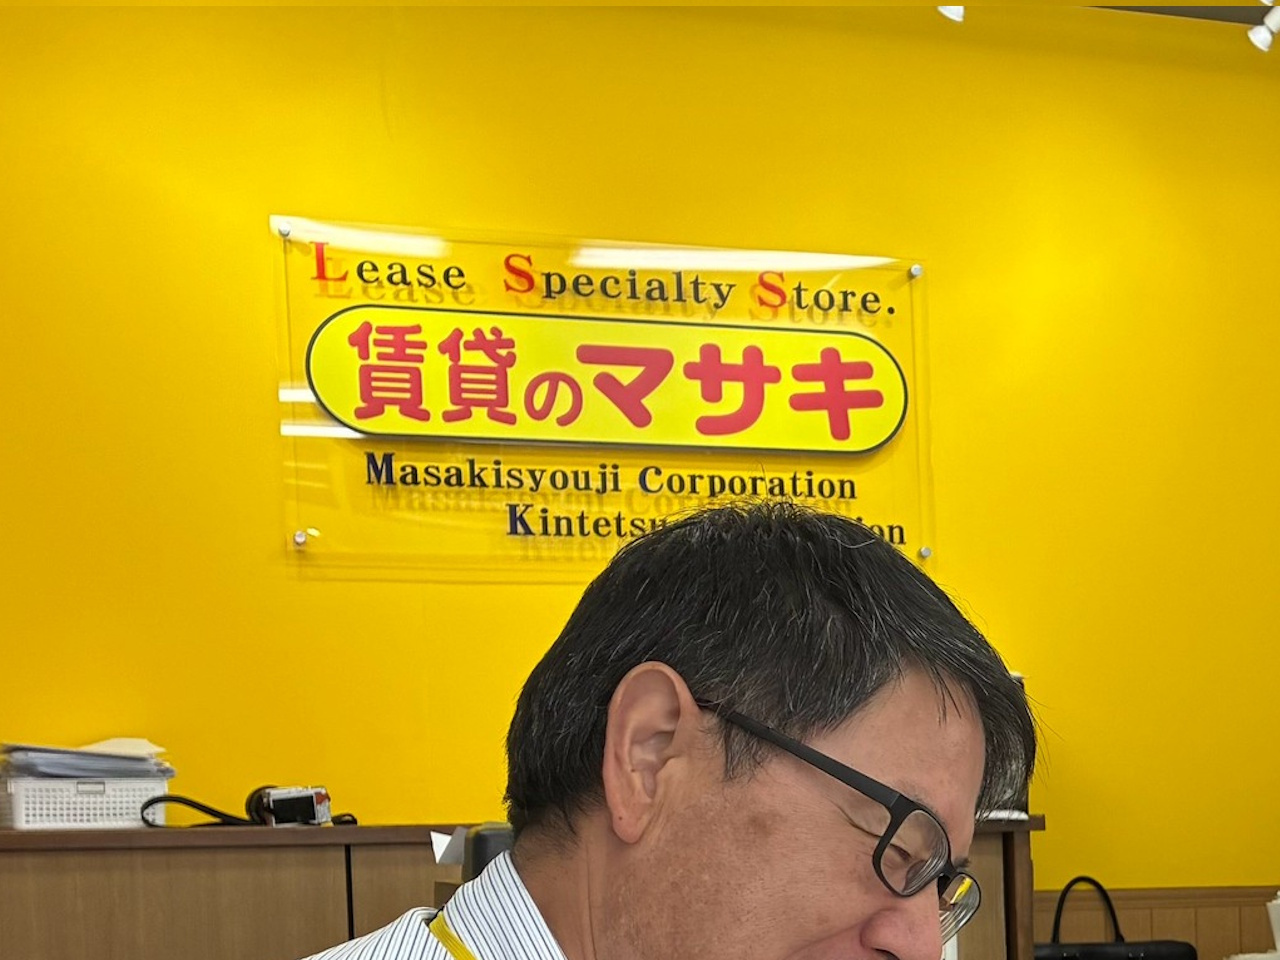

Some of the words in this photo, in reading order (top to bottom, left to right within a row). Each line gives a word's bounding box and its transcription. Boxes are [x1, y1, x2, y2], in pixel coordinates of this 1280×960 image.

[312, 241, 467, 290] Lease
[503, 253, 736, 309] Specialty
[757, 270, 897, 315] Store.
[347, 320, 884, 441] 賃貸のマサキ
[365, 451, 622, 493] Masakisyouji
[638, 466, 857, 498] Corporation
